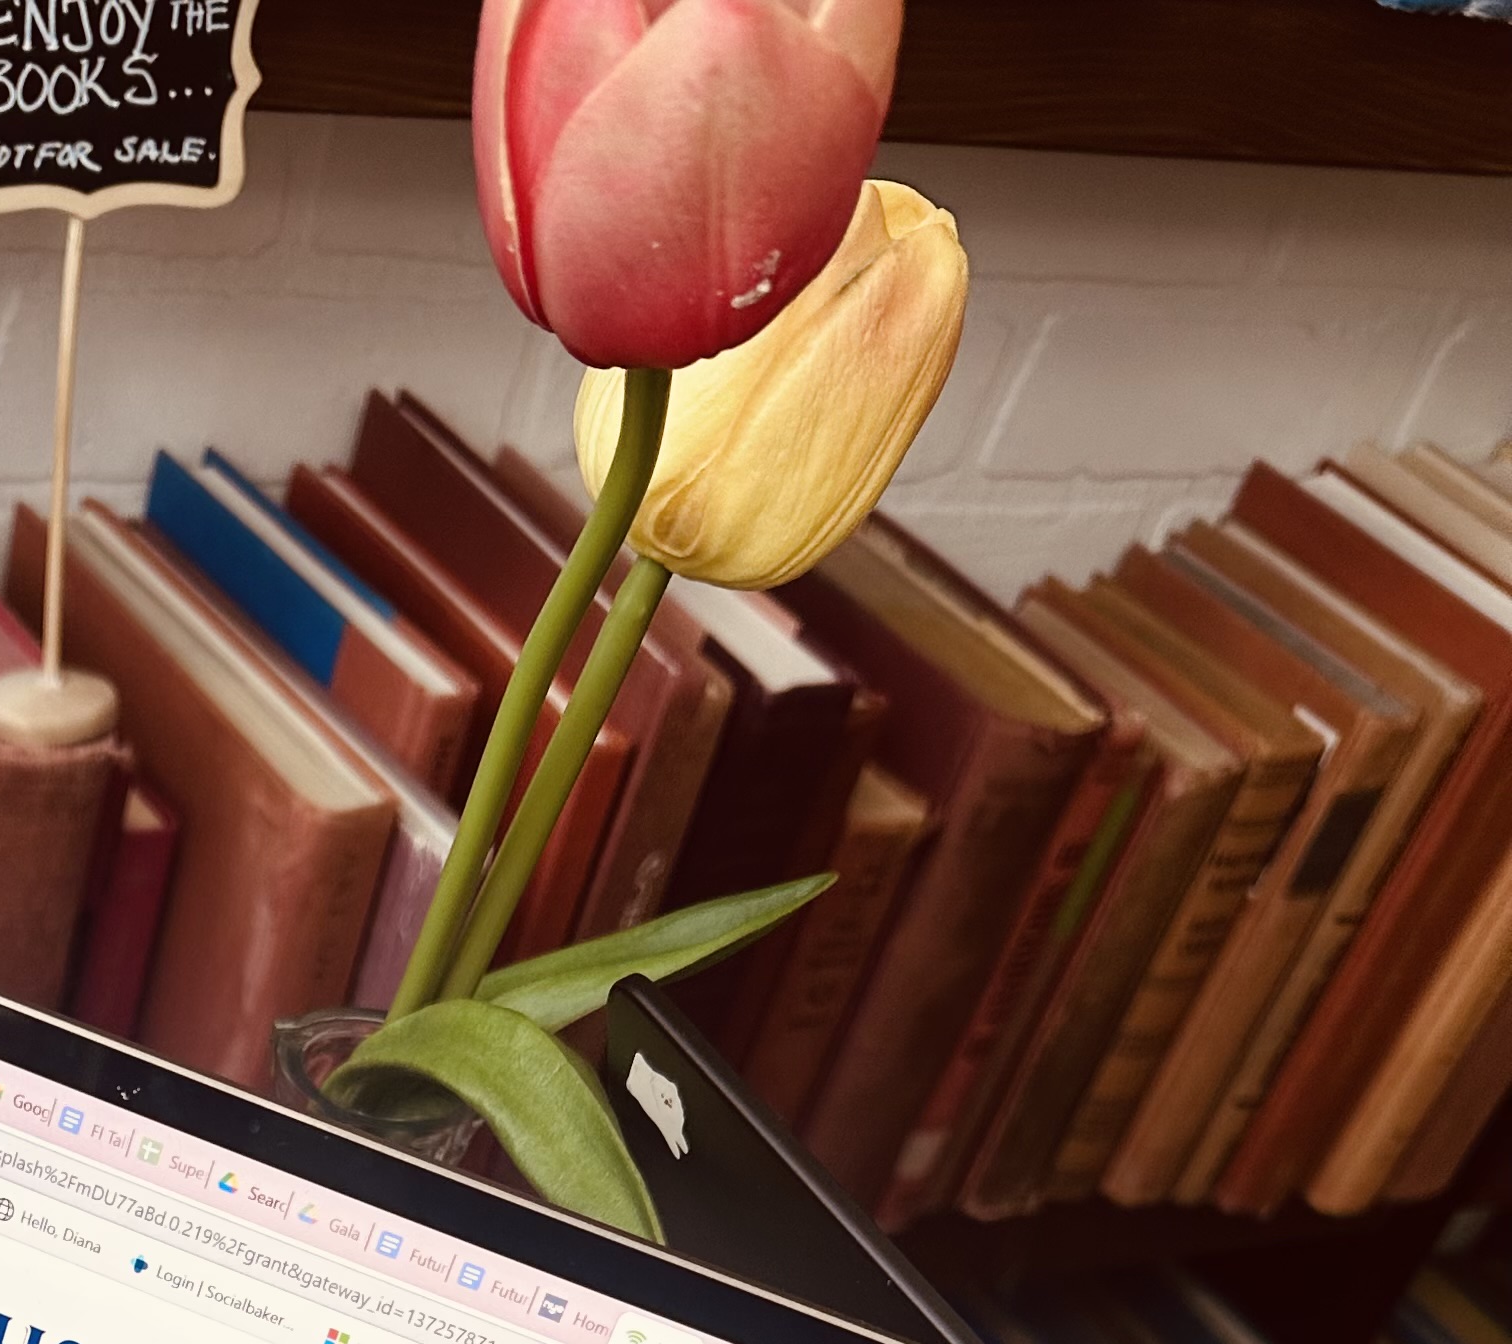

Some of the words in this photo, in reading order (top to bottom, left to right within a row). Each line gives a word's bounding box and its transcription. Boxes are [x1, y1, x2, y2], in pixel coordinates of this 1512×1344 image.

[170, 0, 229, 35] THE
[33, 142, 102, 172] FOR
[115, 138, 216, 164] SALE.
[21, 1211, 59, 1239] Hello,
[63, 1228, 101, 1254] Diana
[329, 1218, 360, 1241] Gala
[156, 1265, 194, 1291] Login
